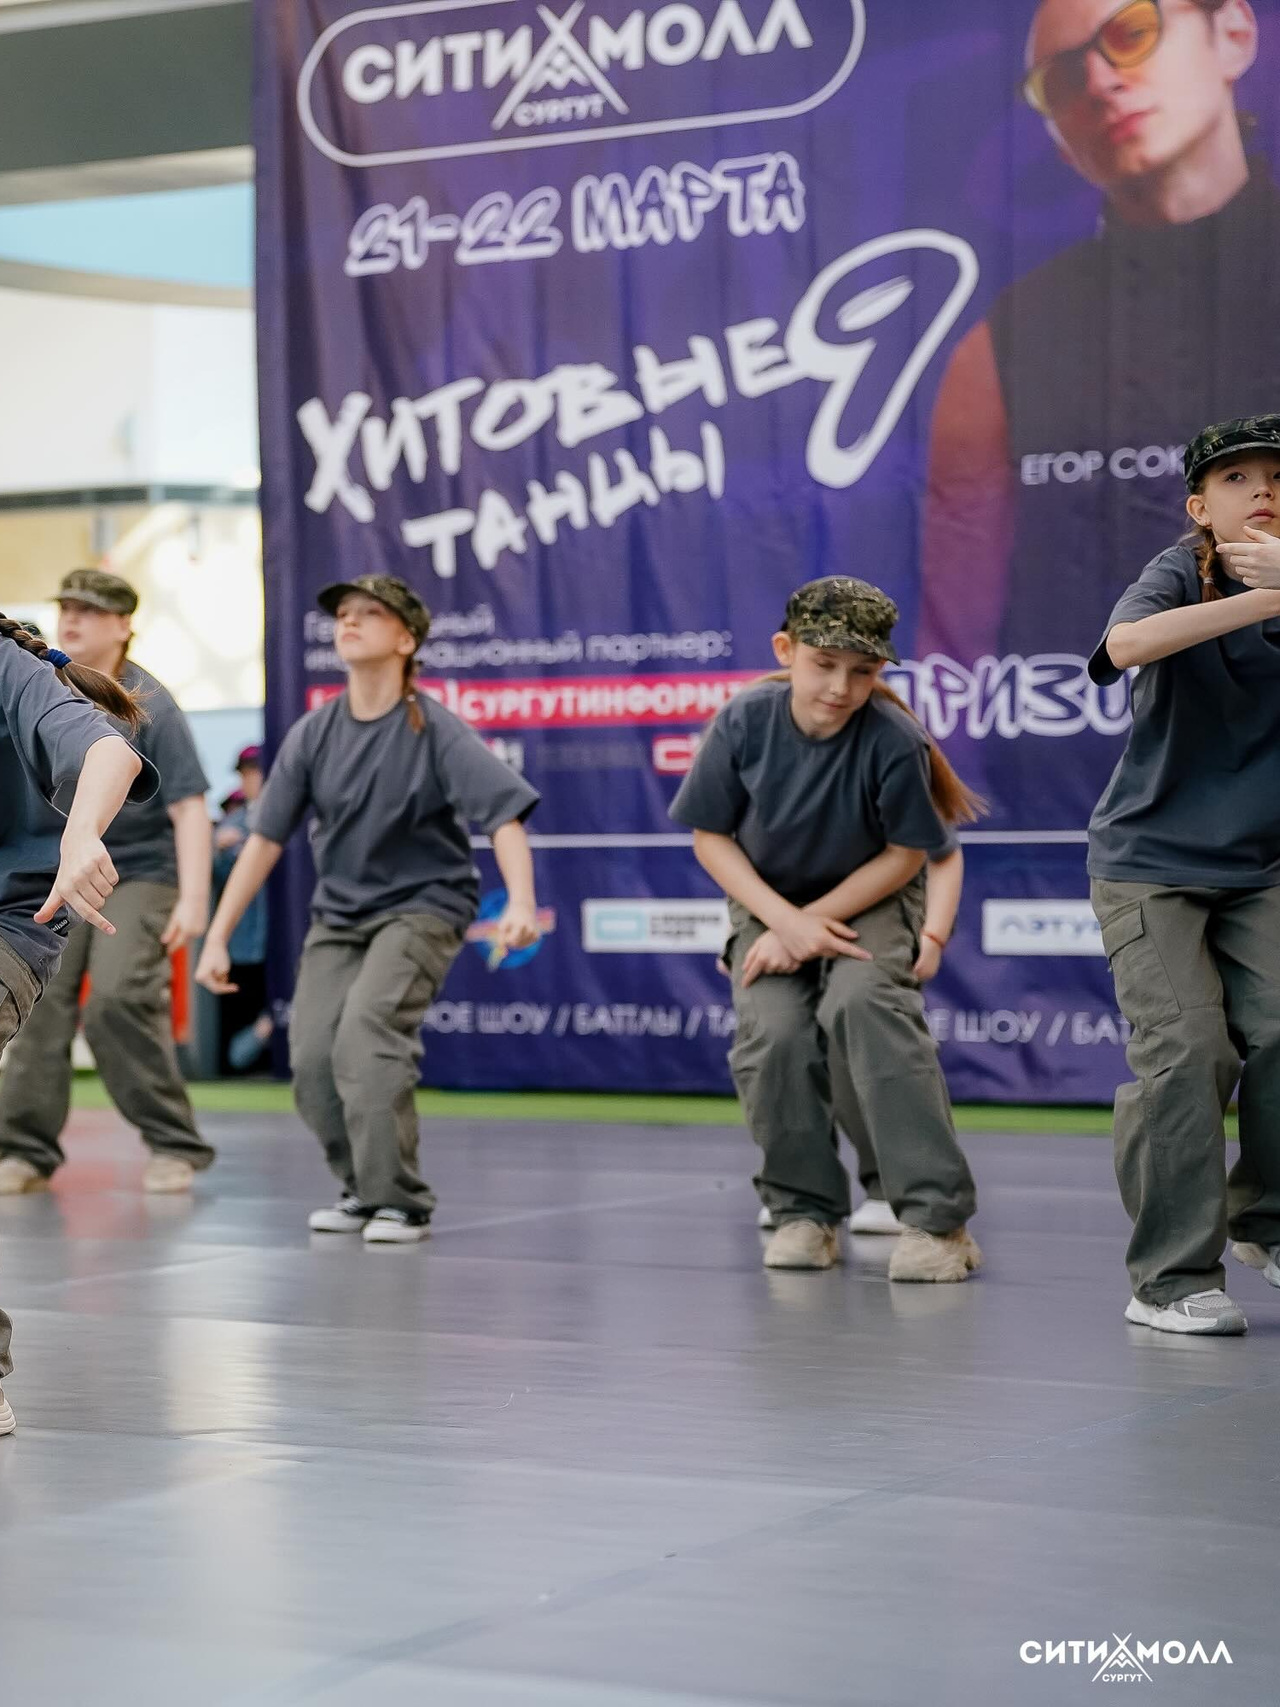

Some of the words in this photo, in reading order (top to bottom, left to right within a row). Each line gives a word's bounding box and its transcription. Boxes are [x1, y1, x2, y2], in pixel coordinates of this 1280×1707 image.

[342, 25, 531, 104] СИТИ
[588, 0, 814, 72] МОЛЛ
[344, 185, 565, 278] 21-22
[570, 151, 807, 254] МАРТА
[296, 316, 790, 523] ХИТОВЫЕ
[1020, 449, 1105, 487] ЕГОР
[401, 420, 726, 579] ТАНЦЫ
[954, 1009, 1043, 1044] ШОУ
